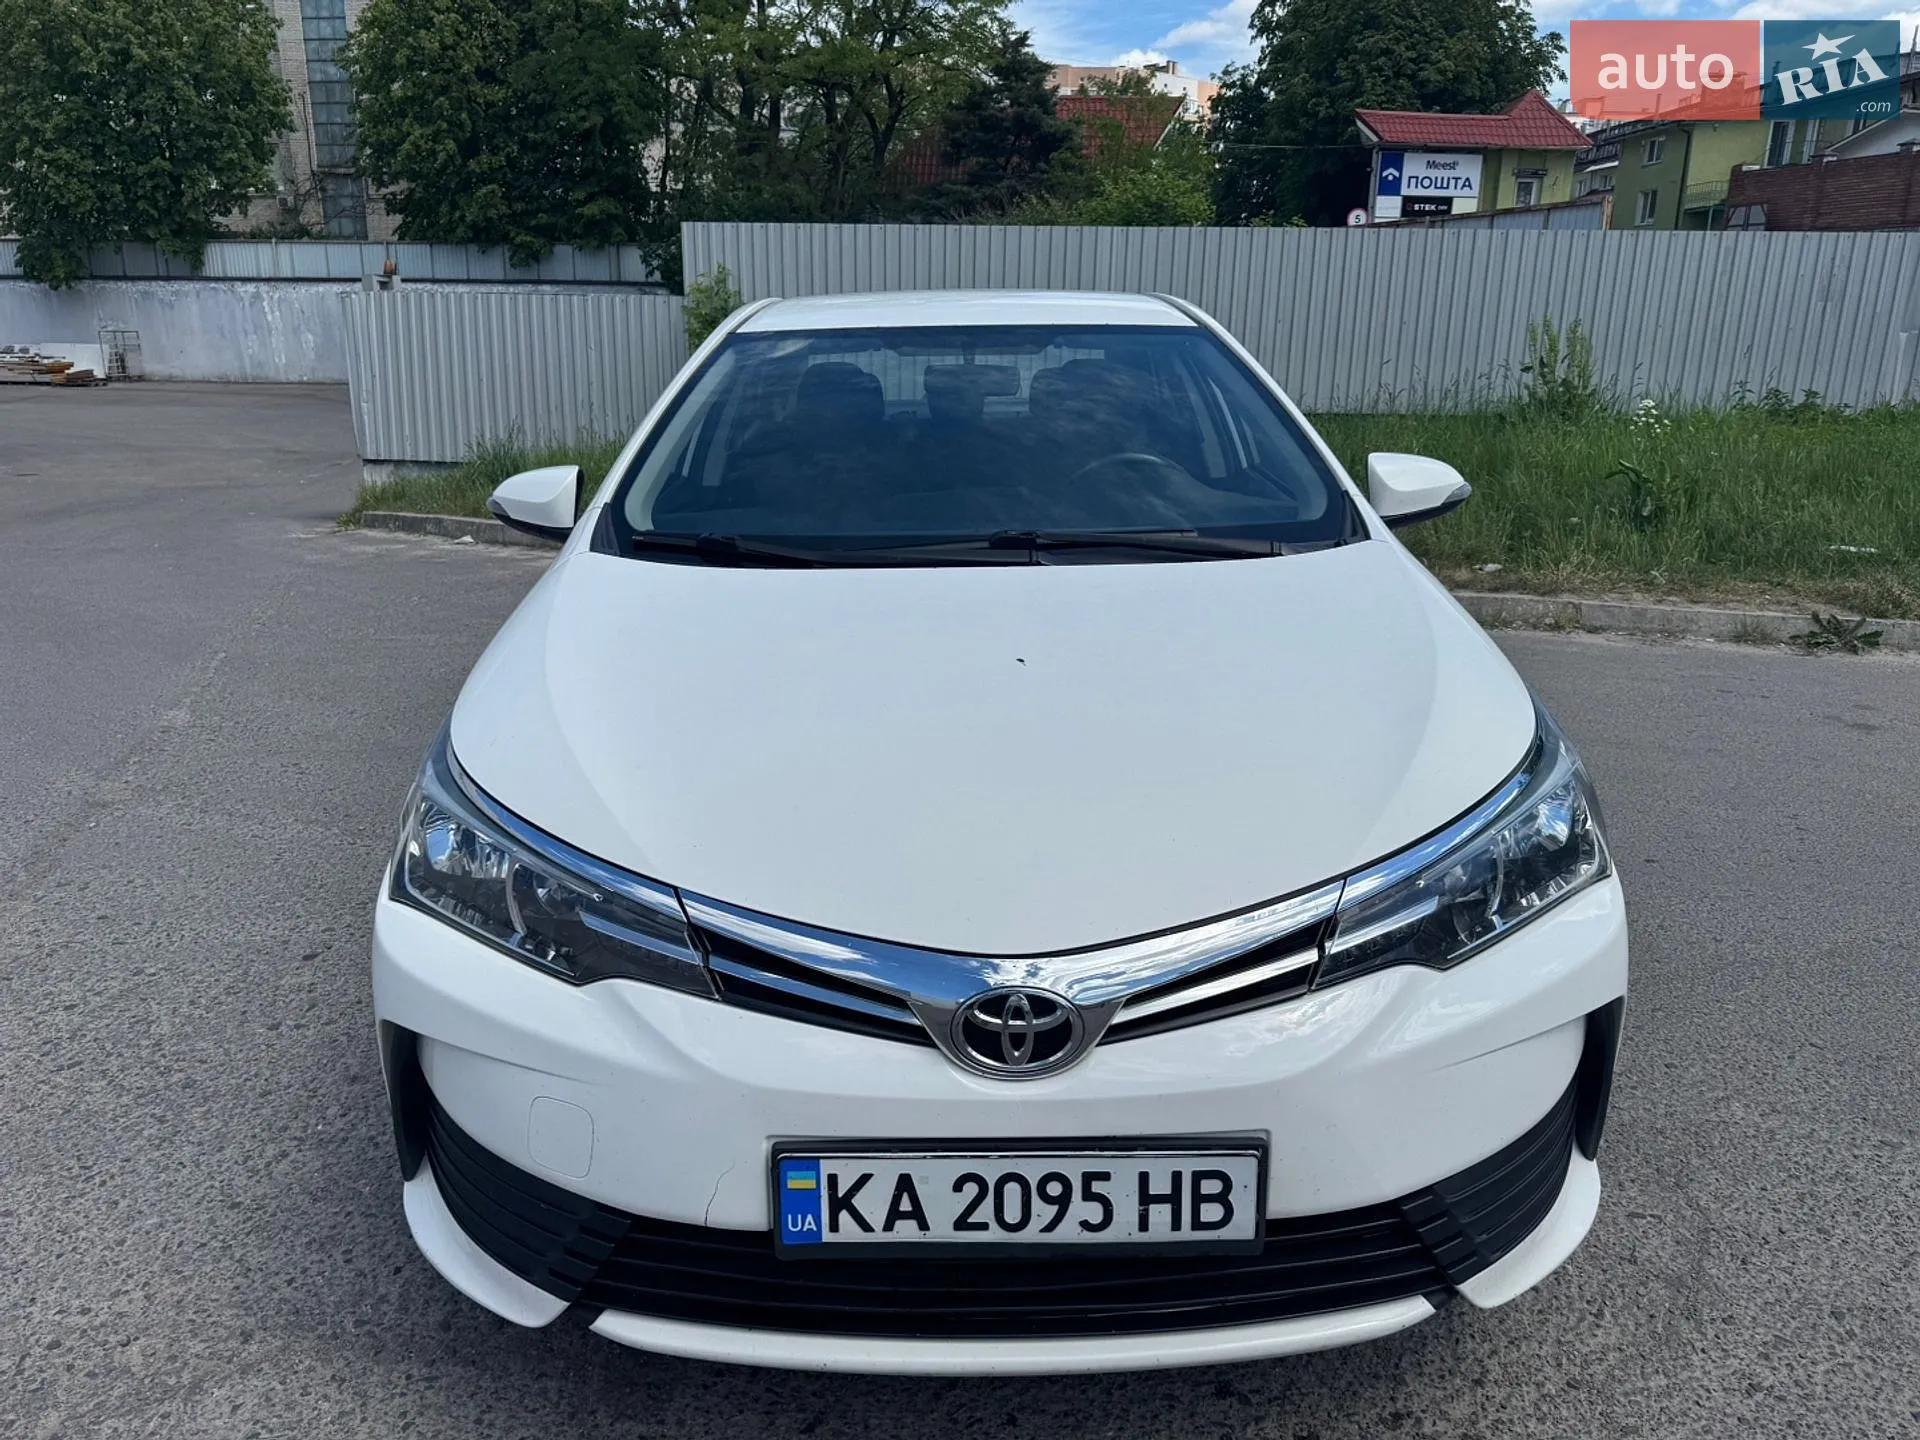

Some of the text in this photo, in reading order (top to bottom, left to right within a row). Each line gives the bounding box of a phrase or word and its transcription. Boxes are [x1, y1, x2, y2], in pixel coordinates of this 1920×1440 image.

[1425, 159, 1457, 171] Meest
[1407, 176, 1473, 191] ПОШТА
[1354, 214, 1362, 224] 5
[827, 1169, 1235, 1234] KA 2095 HB
[788, 1214, 818, 1233] UA
